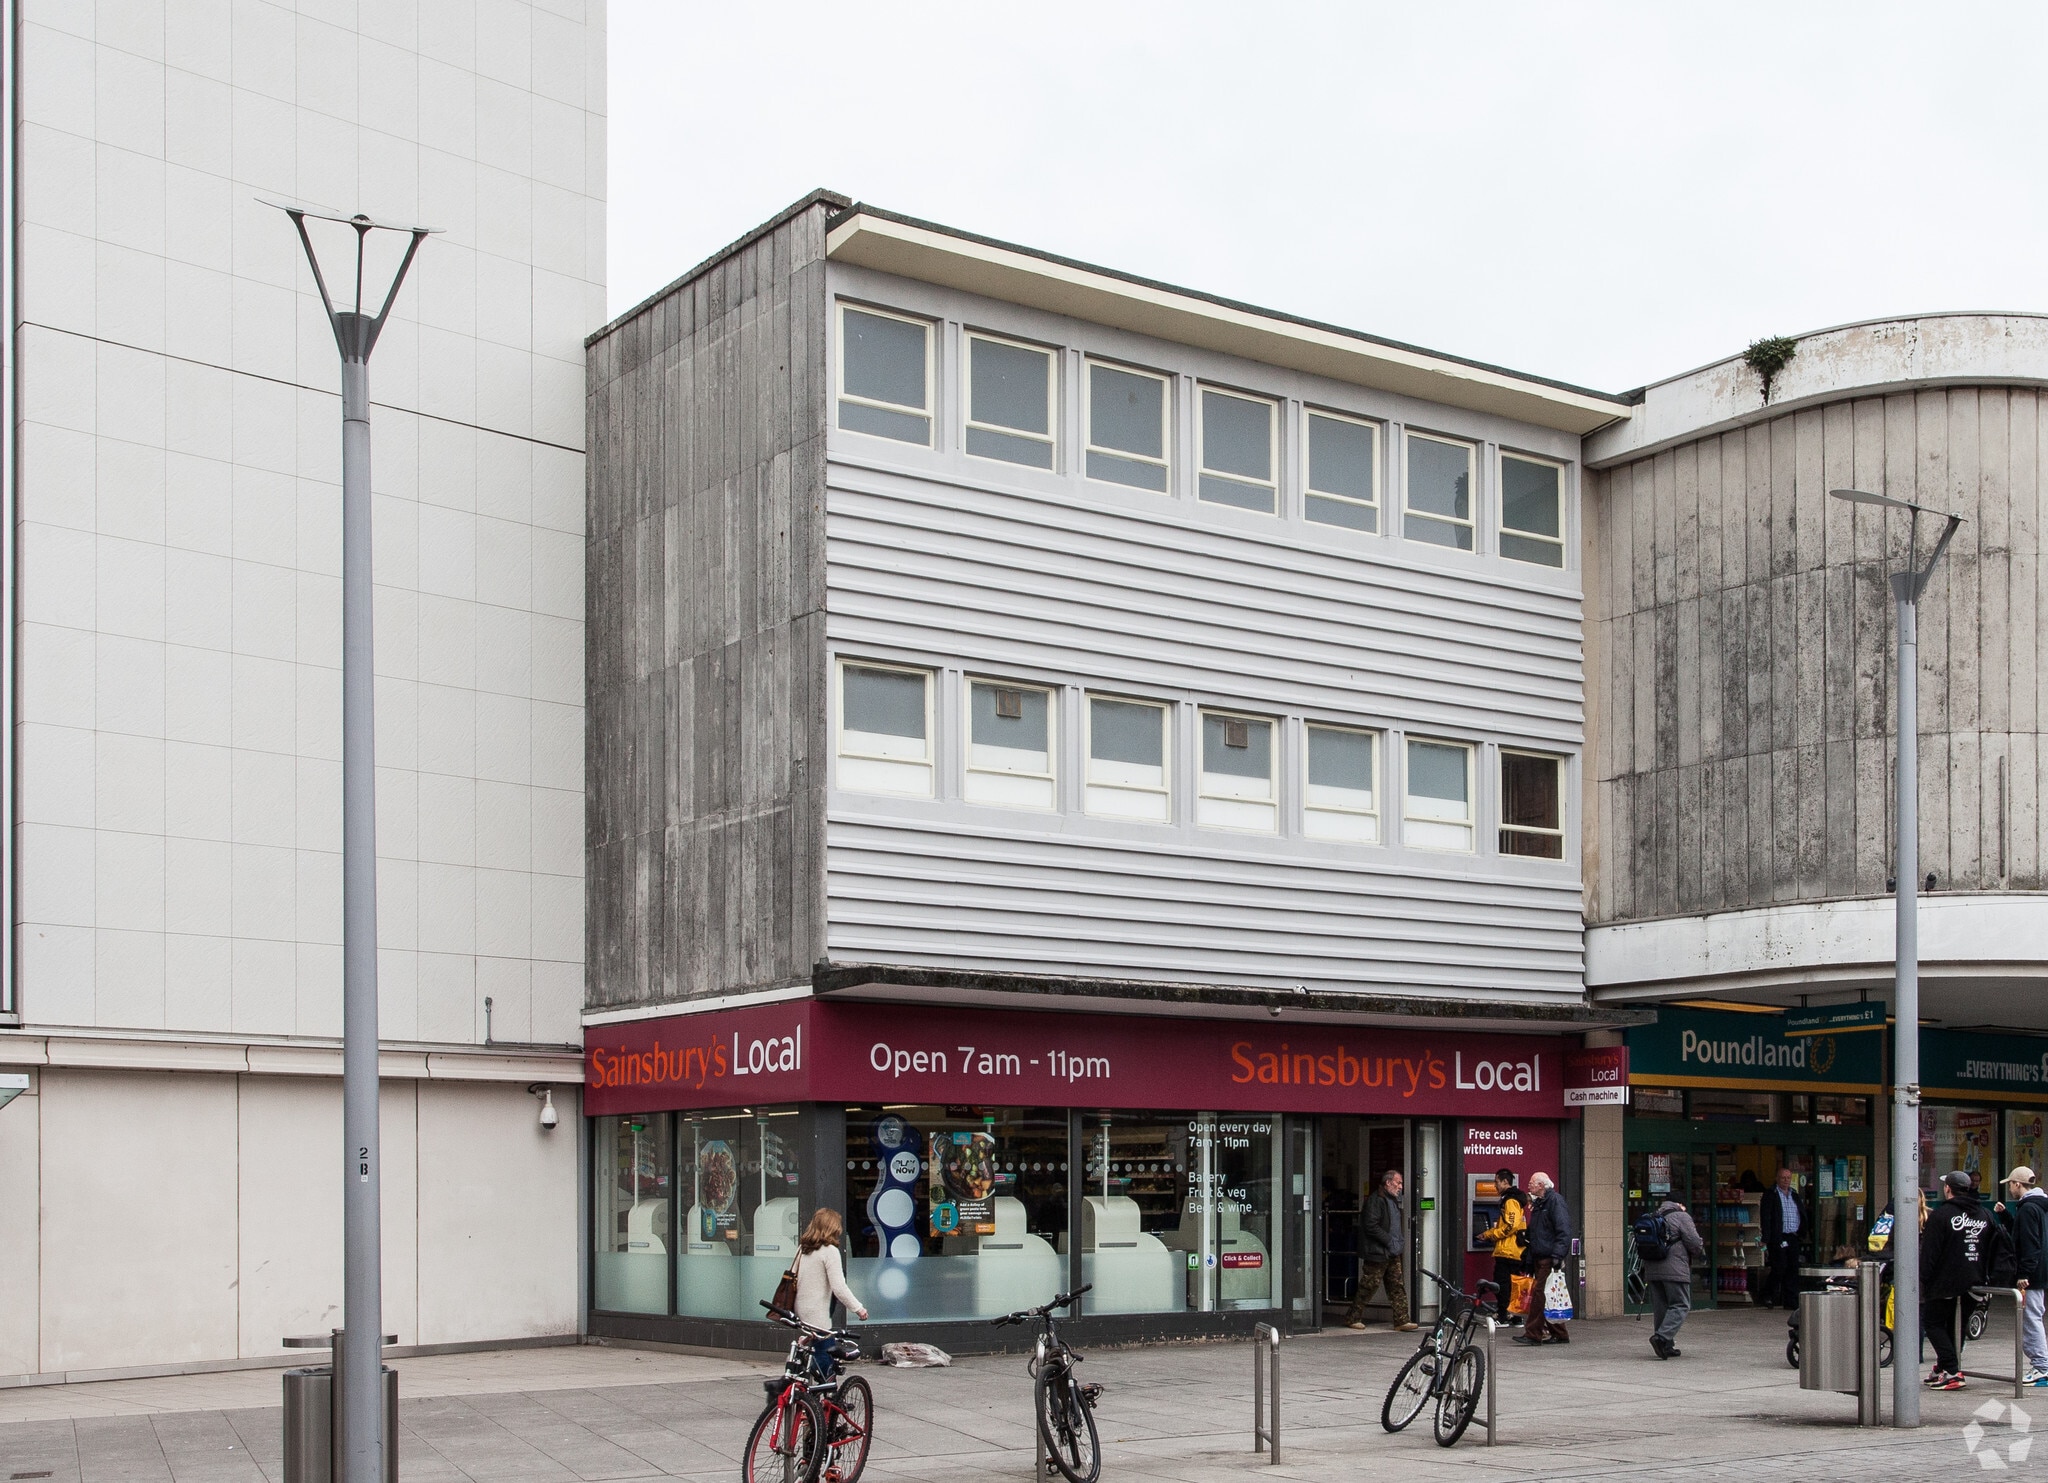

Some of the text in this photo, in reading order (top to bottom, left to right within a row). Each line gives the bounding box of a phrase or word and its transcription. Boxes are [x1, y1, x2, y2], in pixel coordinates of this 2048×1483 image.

[1681, 1029, 1806, 1068] Poundland
[592, 1024, 801, 1089] Sainsbury's Local
[870, 1043, 947, 1078] Open
[957, 1046, 1021, 1075] 7am
[1047, 1050, 1111, 1083] 11pm
[1567, 1054, 1619, 1069] Sainsbury's
[1231, 1041, 1540, 1098] Sainsbury's Local
[1591, 1066, 1619, 1082] Local
[1570, 1090, 1619, 1102] Cash machine
[1188, 1121, 1272, 1135] Open every day
[1468, 1128, 1517, 1140] Free cash
[1188, 1136, 1213, 1148] 7am
[1223, 1136, 1250, 1149] 11pm
[1463, 1143, 1524, 1155] withdrawals
[359, 1147, 368, 1159] 2
[1648, 1154, 1670, 1167] Retail
[360, 1163, 368, 1175] B
[1188, 1171, 1226, 1185] Bakery
[1188, 1186, 1246, 1200] Frut & veg
[1188, 1202, 1252, 1213] Ber & wine
